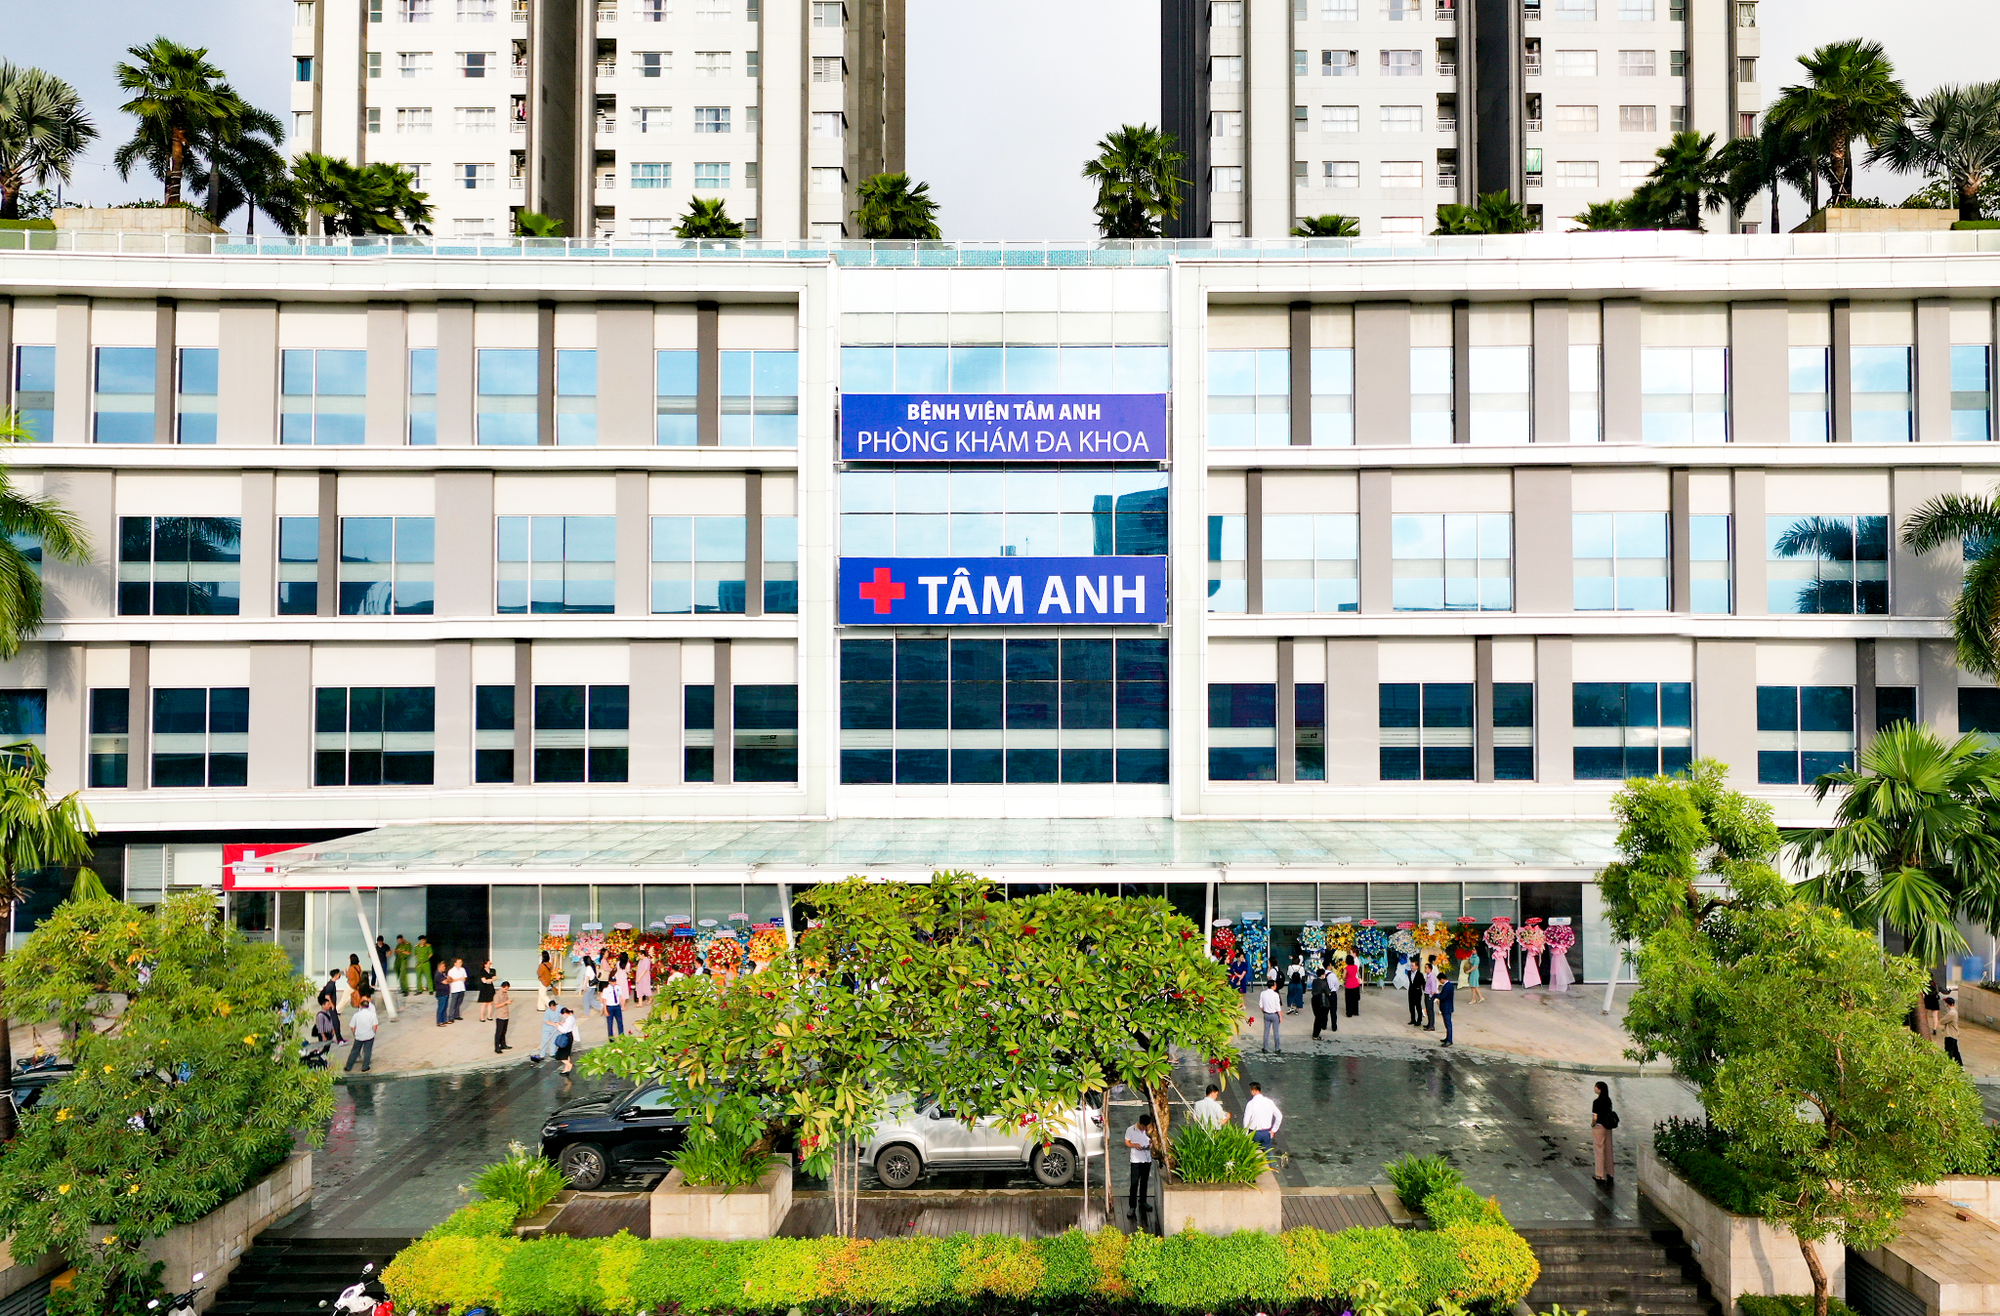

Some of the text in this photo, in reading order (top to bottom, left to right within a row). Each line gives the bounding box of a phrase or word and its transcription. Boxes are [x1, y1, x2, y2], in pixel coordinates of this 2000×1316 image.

[907, 400, 1101, 425] BỆNH VIỆN TÂM ANH
[858, 425, 1151, 453] PHÒNG KHÁM ĐA KHOA
[918, 567, 1147, 614] TÂM ANH
